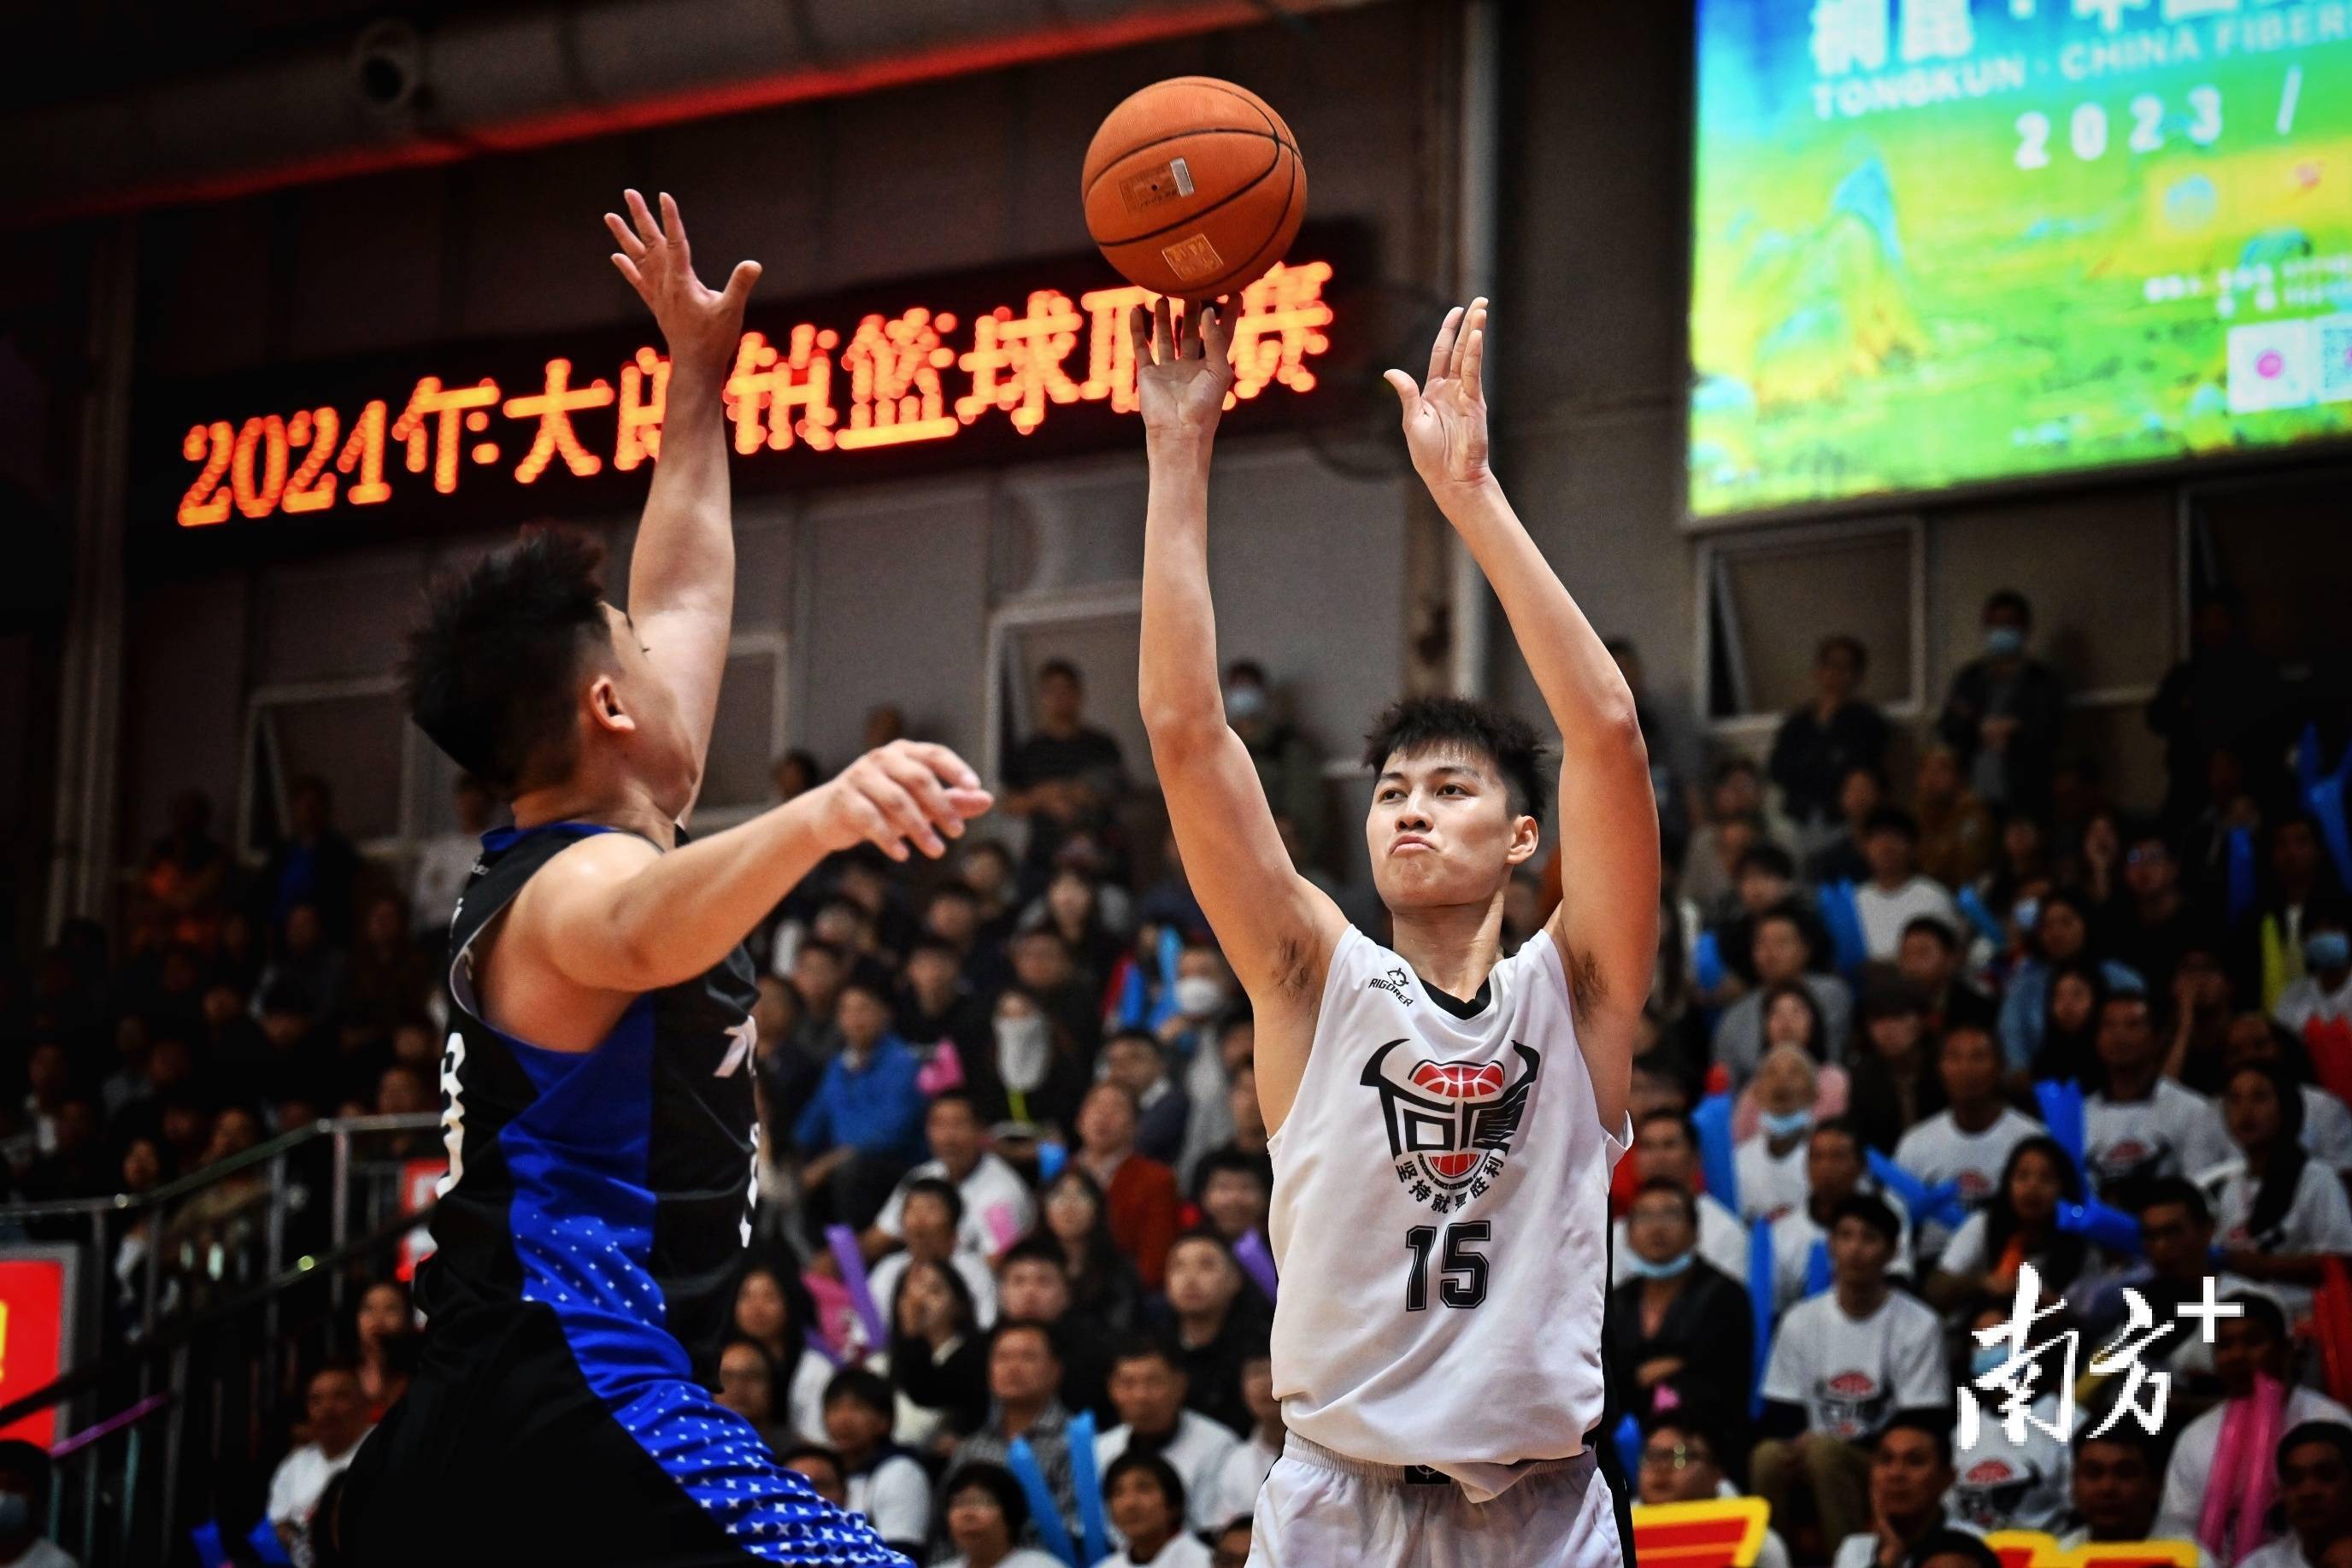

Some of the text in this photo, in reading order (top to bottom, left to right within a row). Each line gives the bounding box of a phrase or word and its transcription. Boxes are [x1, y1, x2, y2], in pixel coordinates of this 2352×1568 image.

[1813, 54, 2026, 120] TONGKUN
[2059, 24, 2200, 81] CHINA
[2215, 3, 2352, 56] FIBER
[2015, 85, 2224, 169] 2023
[1368, 978, 1414, 1007] RIGORER
[1396, 1156, 1505, 1214] 坚持就是胜利
[1405, 1220, 1491, 1313] 15
